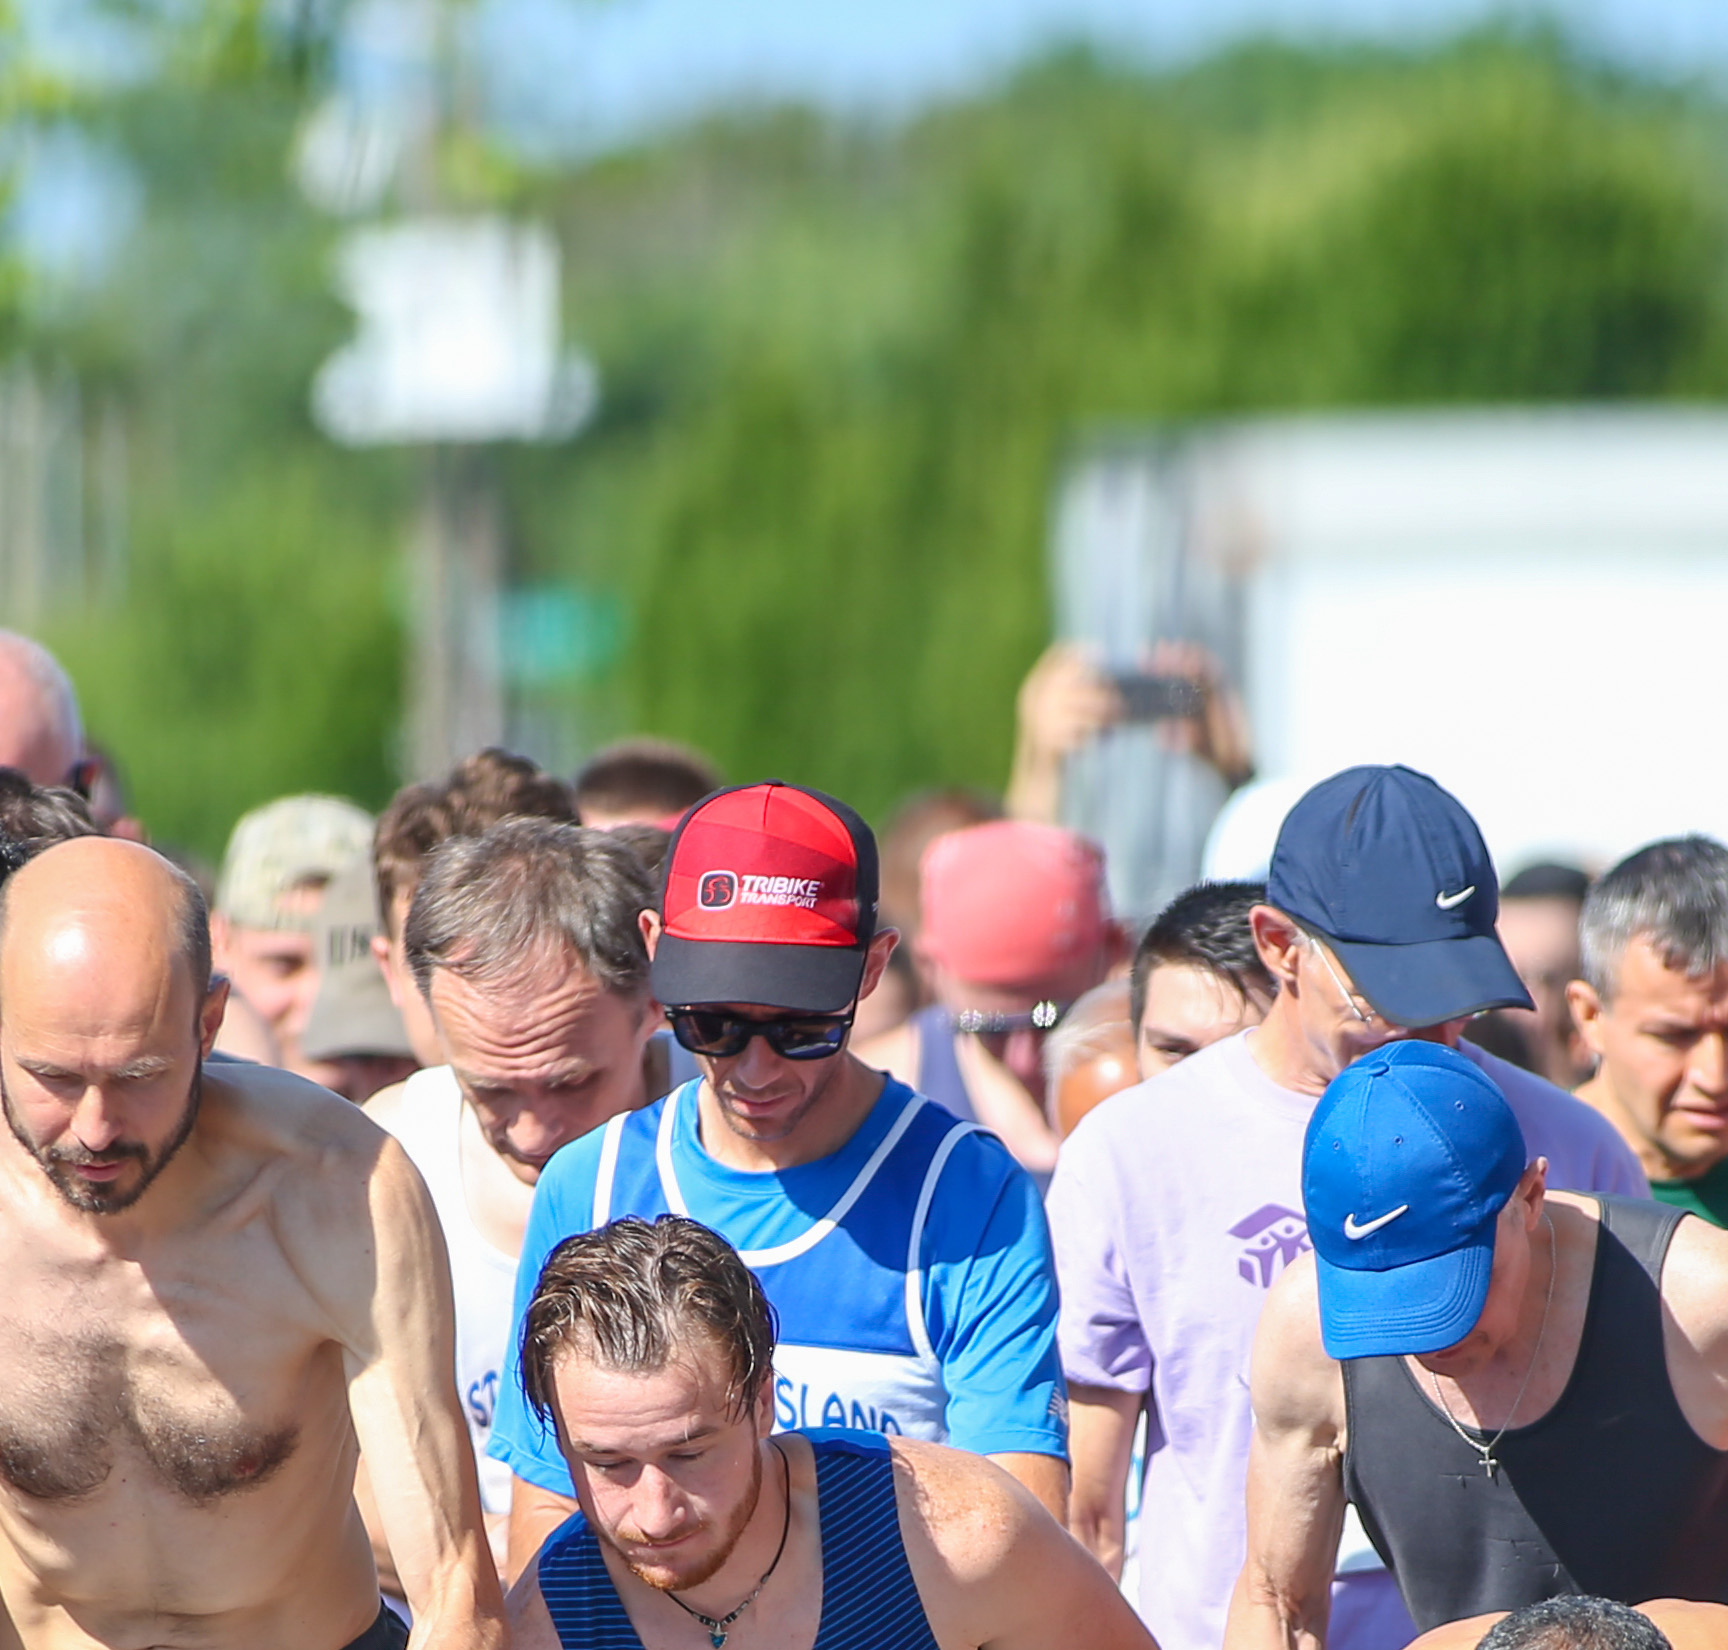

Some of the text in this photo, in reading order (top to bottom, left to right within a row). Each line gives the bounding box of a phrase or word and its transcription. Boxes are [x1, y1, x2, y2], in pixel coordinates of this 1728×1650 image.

[741, 875, 821, 898] TRIBIKE
[740, 892, 819, 909] TRANSPORT
[774, 1375, 904, 1435] SLAND
